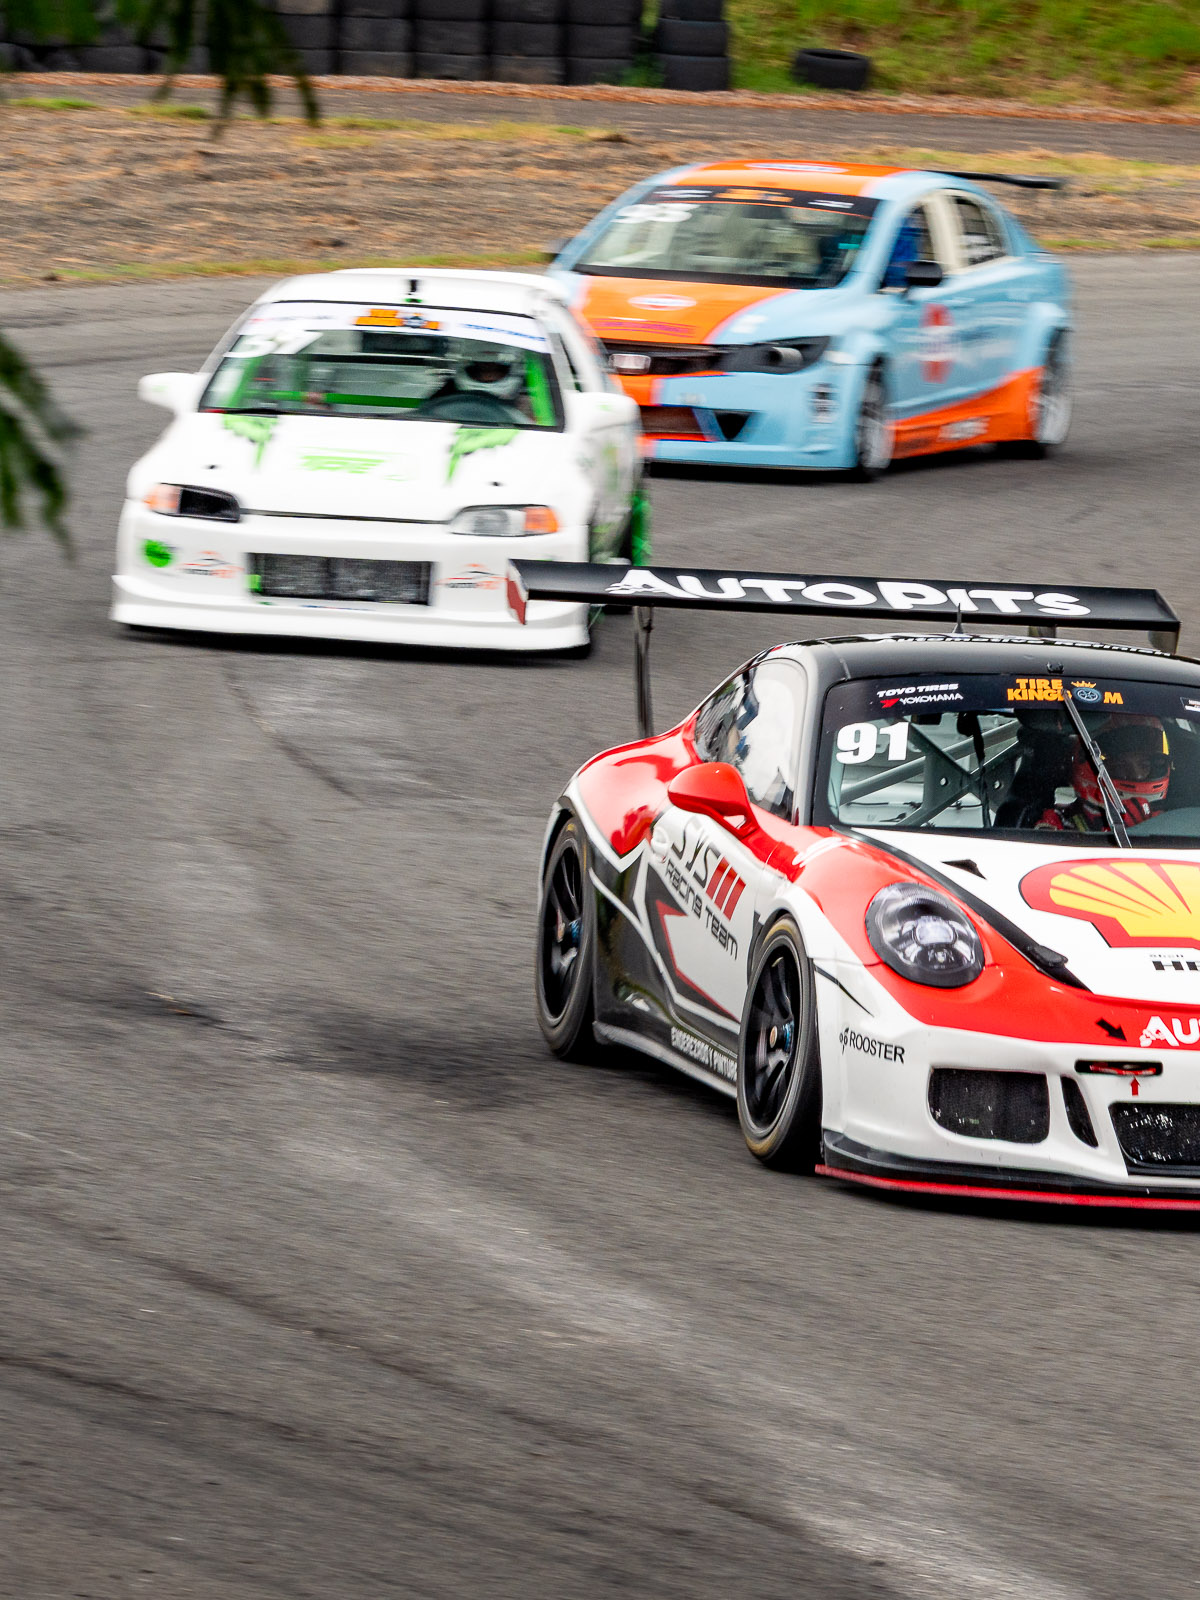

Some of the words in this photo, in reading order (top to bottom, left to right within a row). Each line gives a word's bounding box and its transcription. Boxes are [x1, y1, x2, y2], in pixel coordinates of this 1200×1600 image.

[605, 569, 1091, 616] AUTOPITS
[876, 687, 916, 698] TOYO
[917, 683, 959, 693] TIRES
[1016, 679, 1063, 690] TIRE
[900, 693, 964, 705] YOKOHAMA
[836, 721, 909, 764] 91
[849, 1030, 905, 1064] ROOSTER
